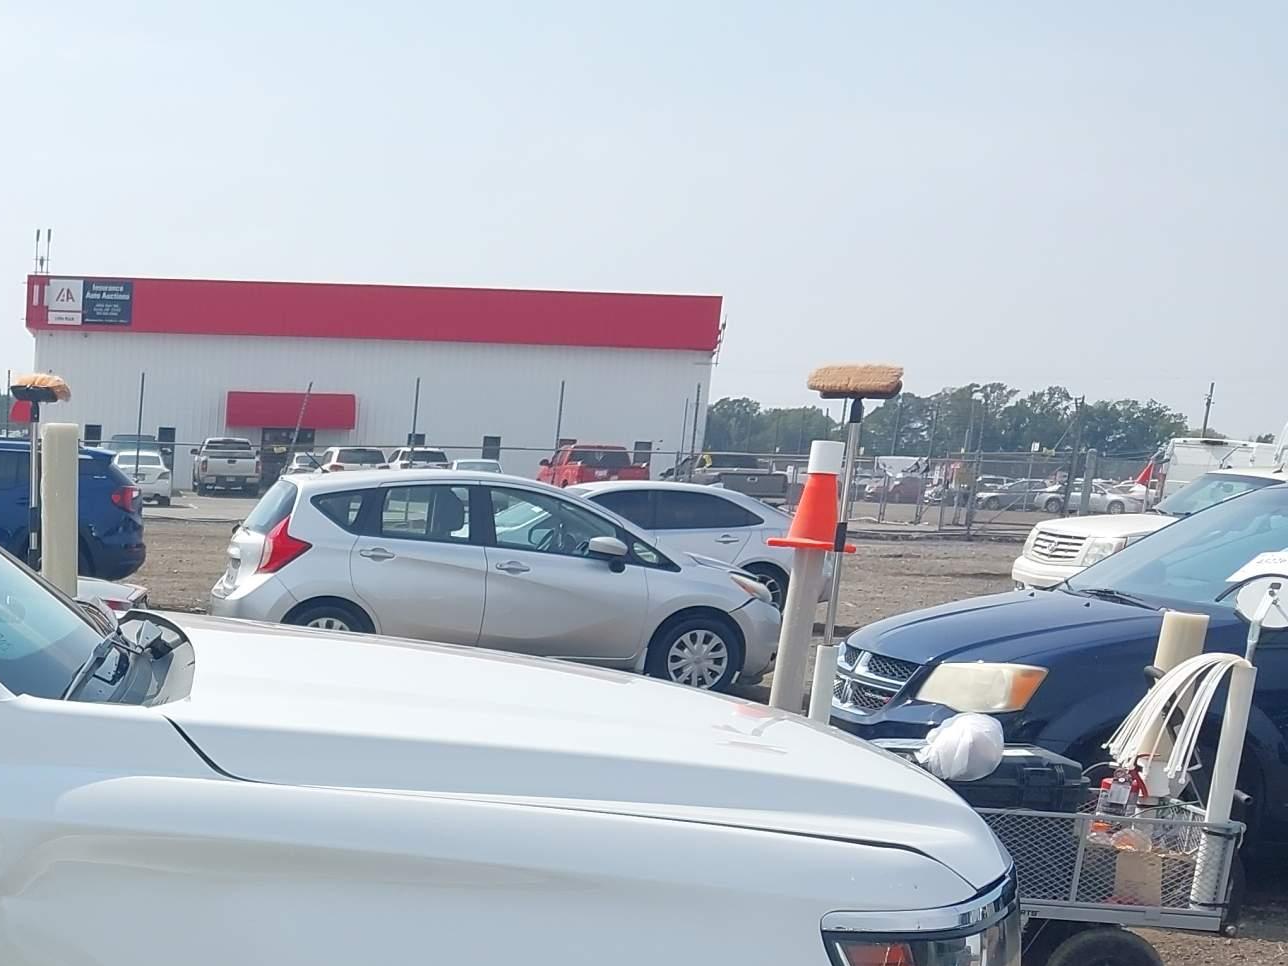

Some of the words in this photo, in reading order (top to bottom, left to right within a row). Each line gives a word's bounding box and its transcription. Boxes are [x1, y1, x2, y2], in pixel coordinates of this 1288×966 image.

[92, 283, 124, 291] Insurance
[85, 291, 101, 300] Auto
[101, 291, 130, 300] Auctions
